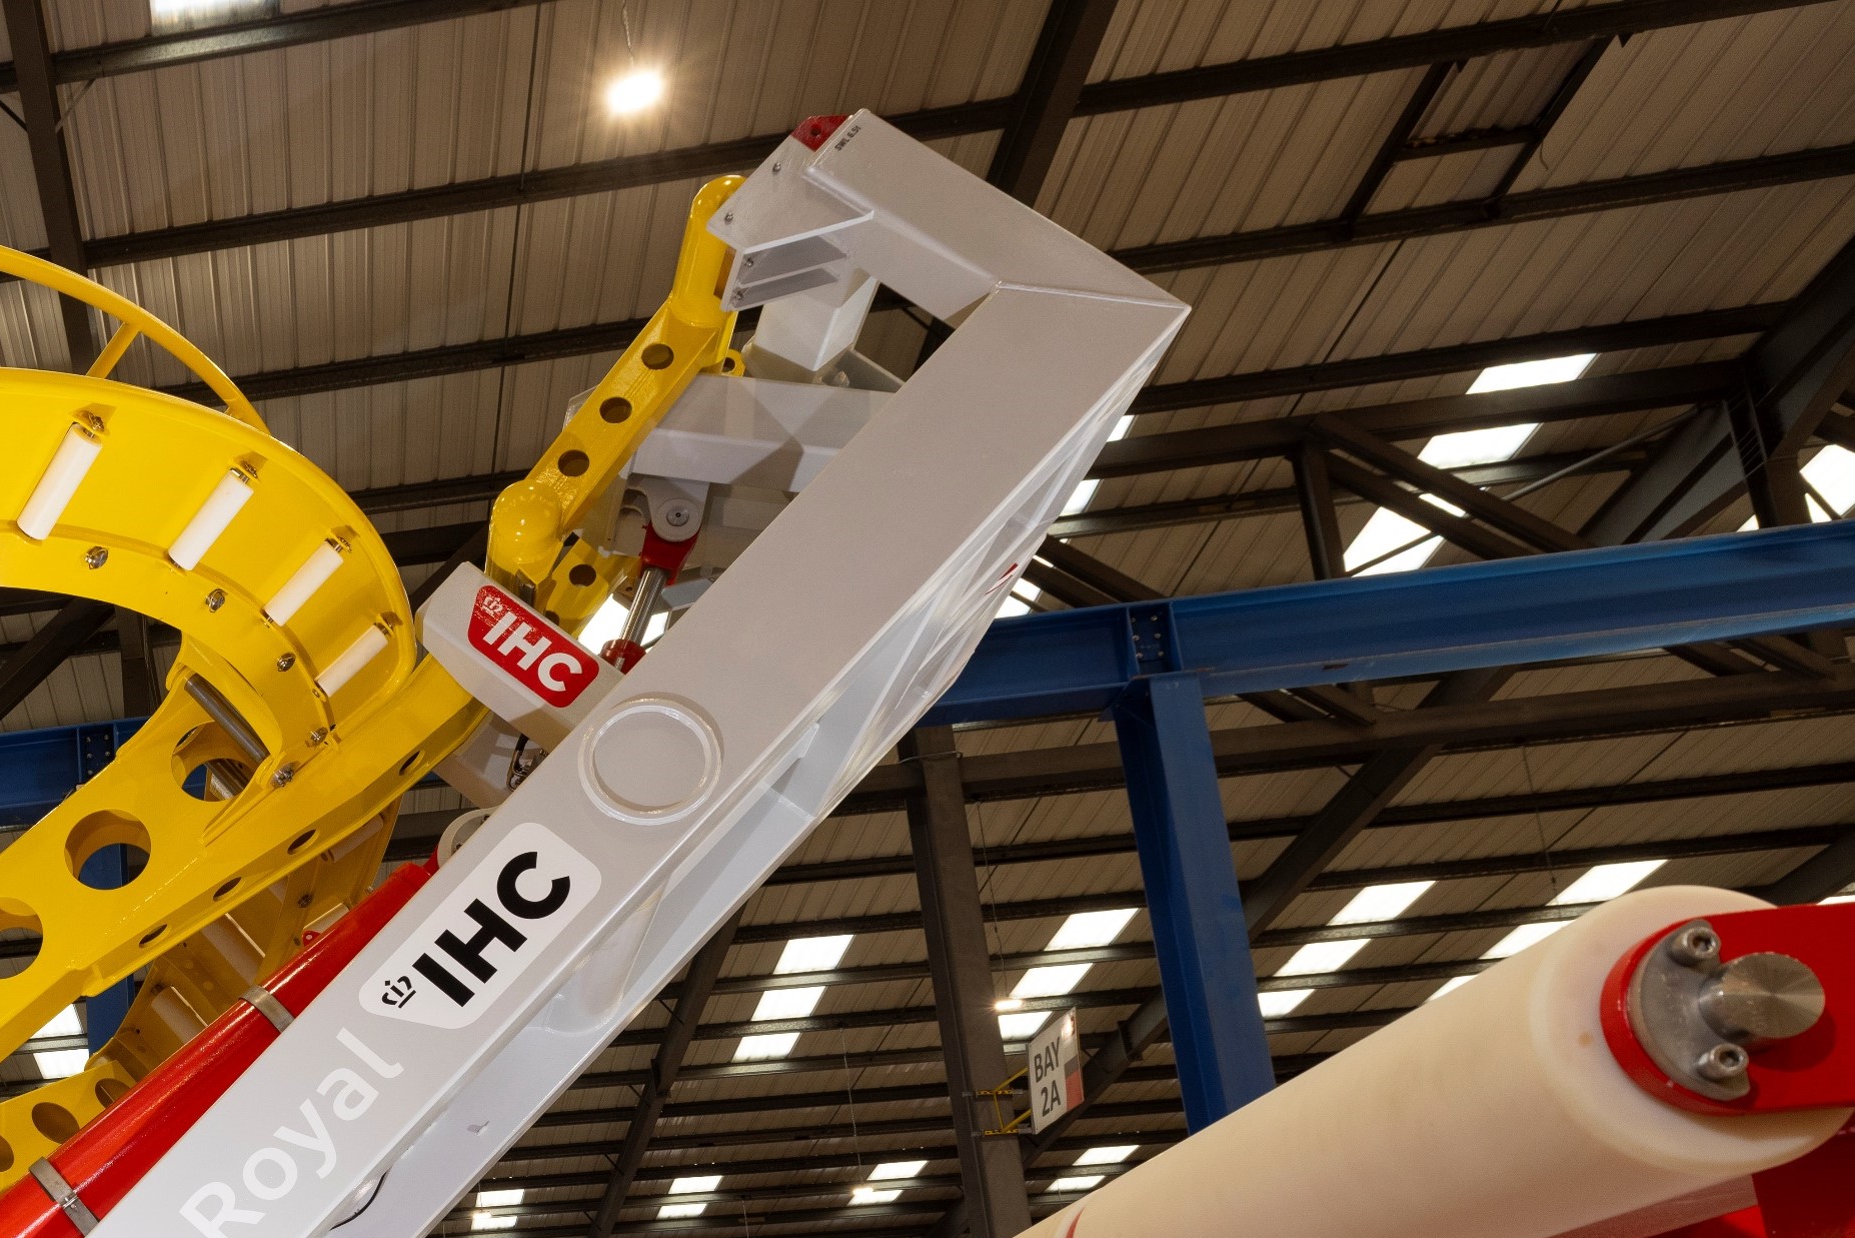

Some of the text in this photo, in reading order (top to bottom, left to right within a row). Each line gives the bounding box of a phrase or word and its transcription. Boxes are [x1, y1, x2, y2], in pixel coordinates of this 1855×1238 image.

[482, 611, 583, 692] IHC
[412, 851, 571, 1008] IHC
[1033, 1036, 1061, 1083] BAY
[1040, 1080, 1062, 1118] 2A
